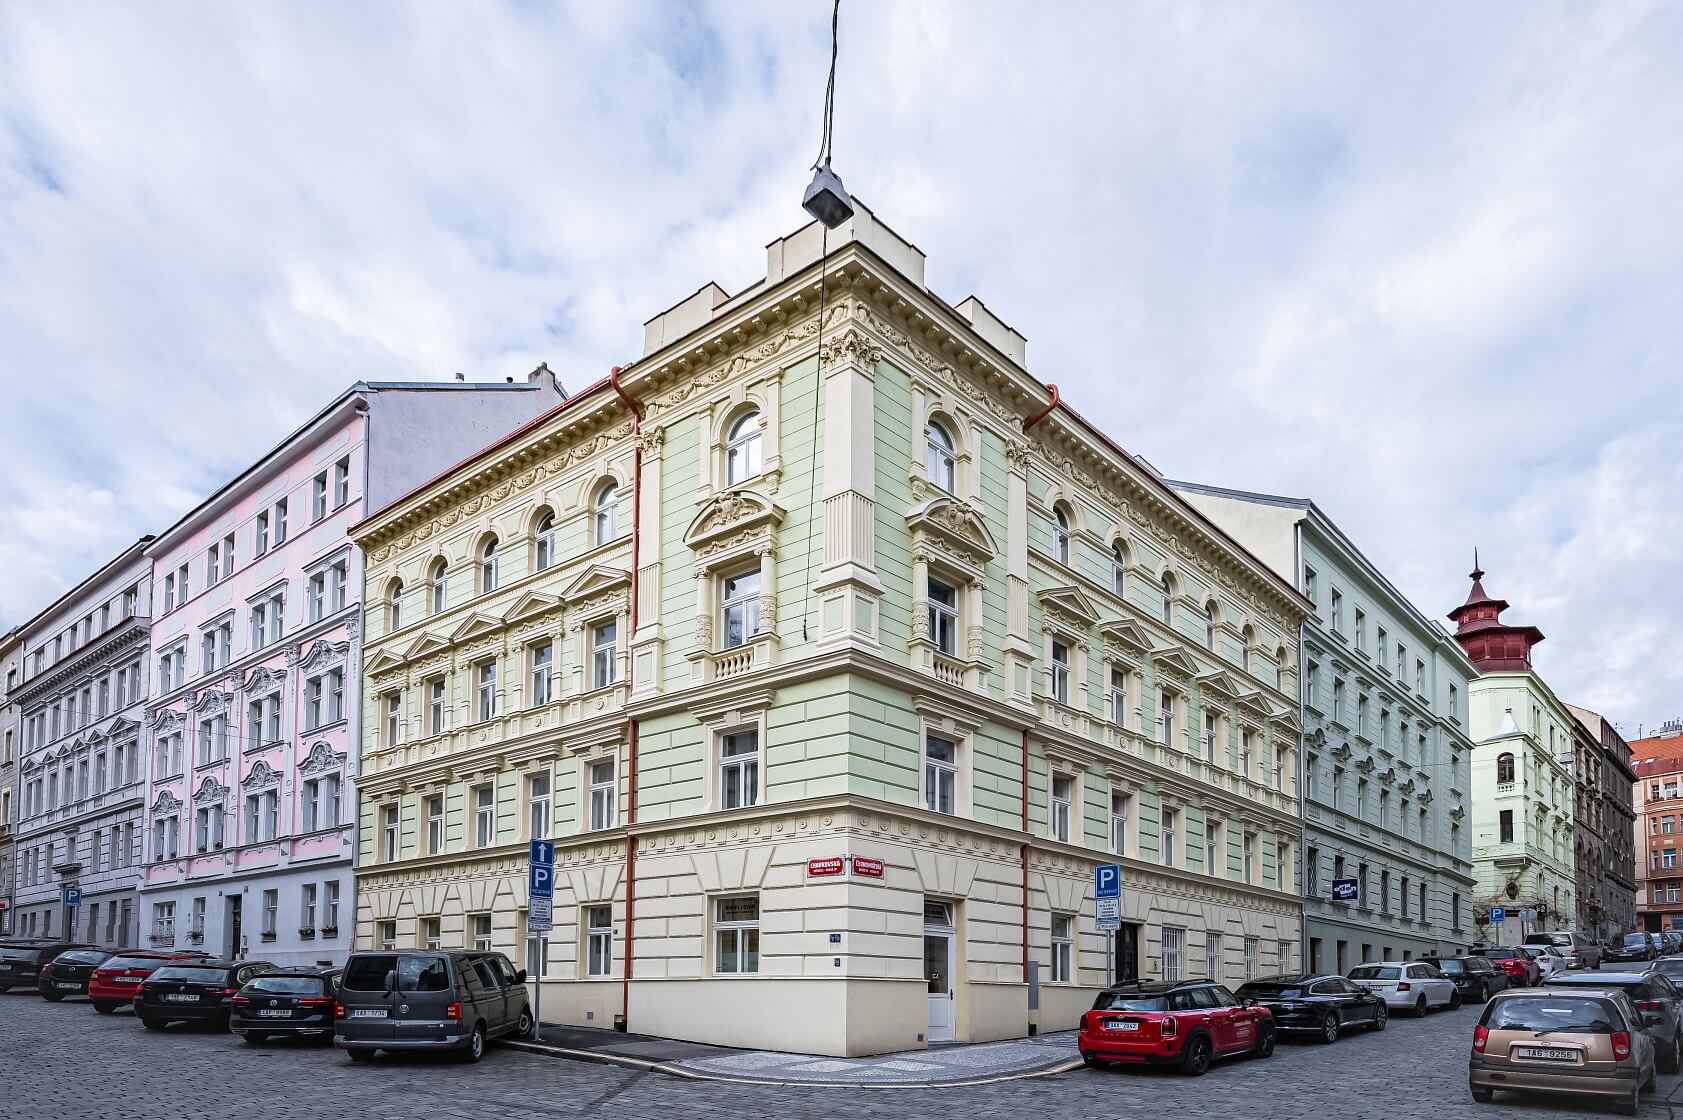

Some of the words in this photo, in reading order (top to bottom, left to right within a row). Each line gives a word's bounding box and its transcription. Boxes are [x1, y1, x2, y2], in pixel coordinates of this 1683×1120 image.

[534, 868, 549, 888] P
[1100, 869, 1114, 889] P
[69, 890, 78, 901] P
[1492, 908, 1502, 918] P
[1549, 1050, 1573, 1059] 9256
